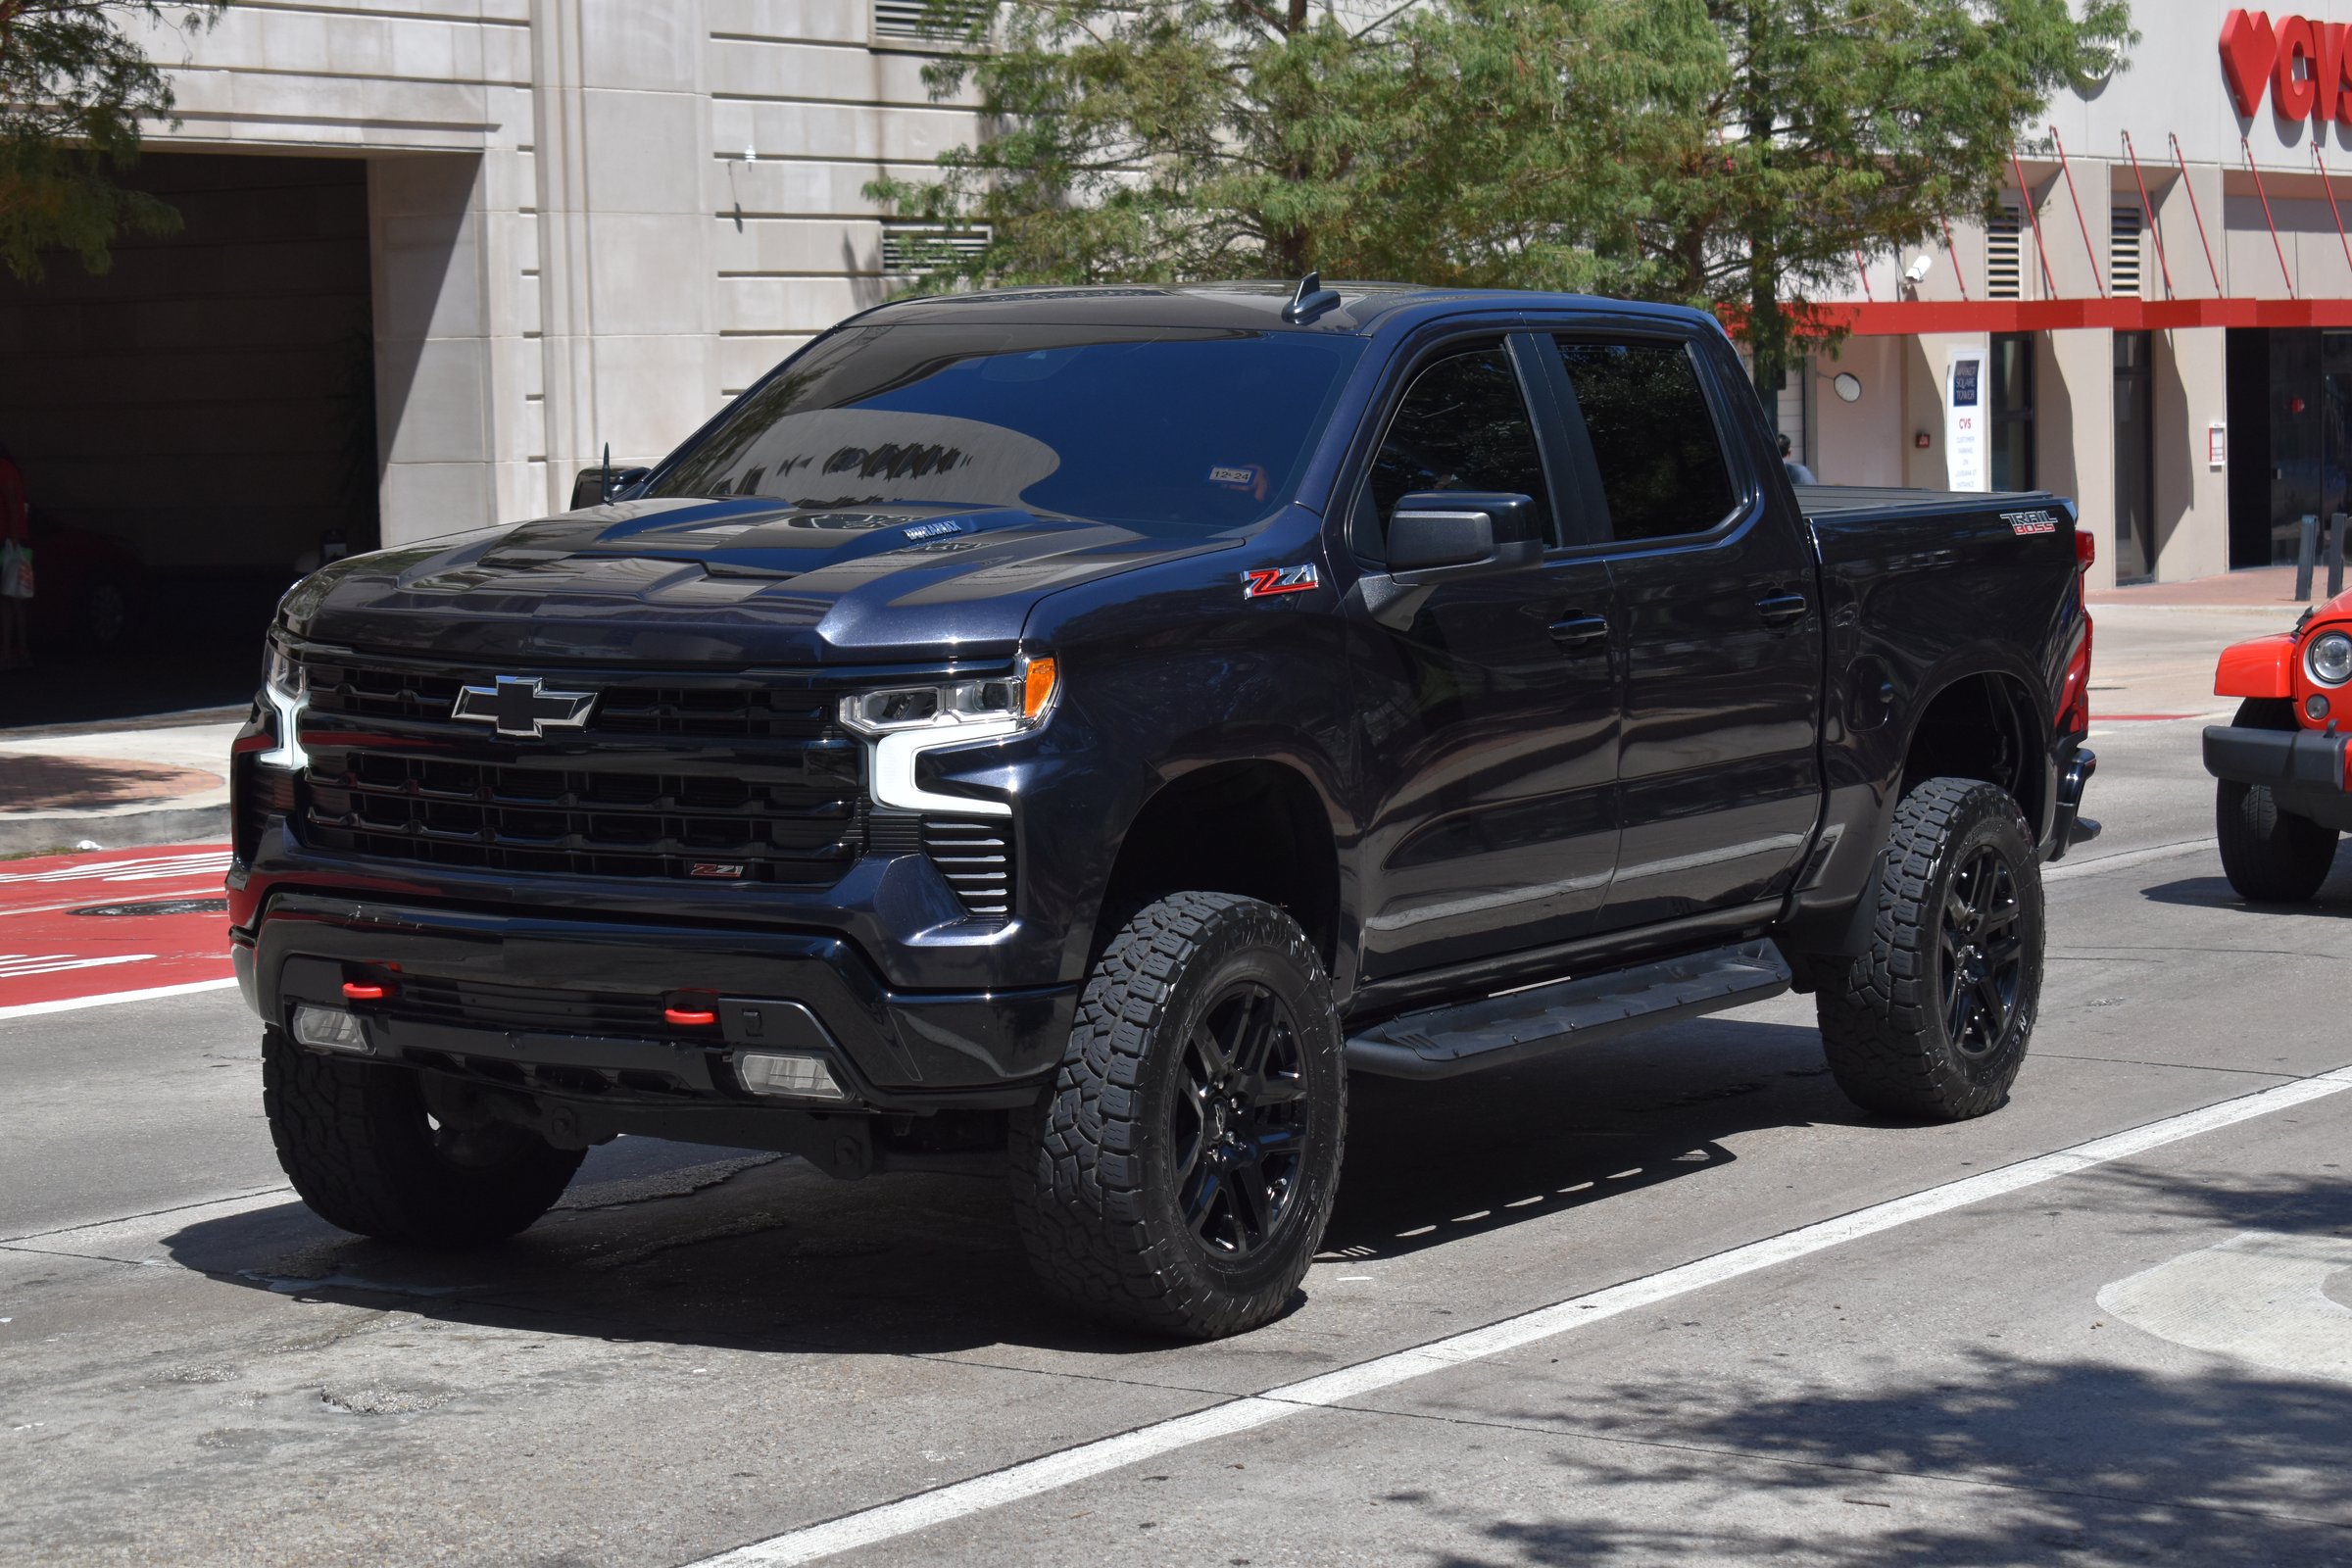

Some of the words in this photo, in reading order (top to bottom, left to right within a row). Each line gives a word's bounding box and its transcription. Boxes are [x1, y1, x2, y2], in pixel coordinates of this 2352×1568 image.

[1956, 377, 1976, 389] SQUARE
[1956, 390, 1975, 401] TOWER
[1959, 417, 1972, 430] CVS
[1999, 511, 2058, 525] TRAIL
[2014, 522, 2055, 535] BOSS
[1242, 564, 1318, 600] Z71
